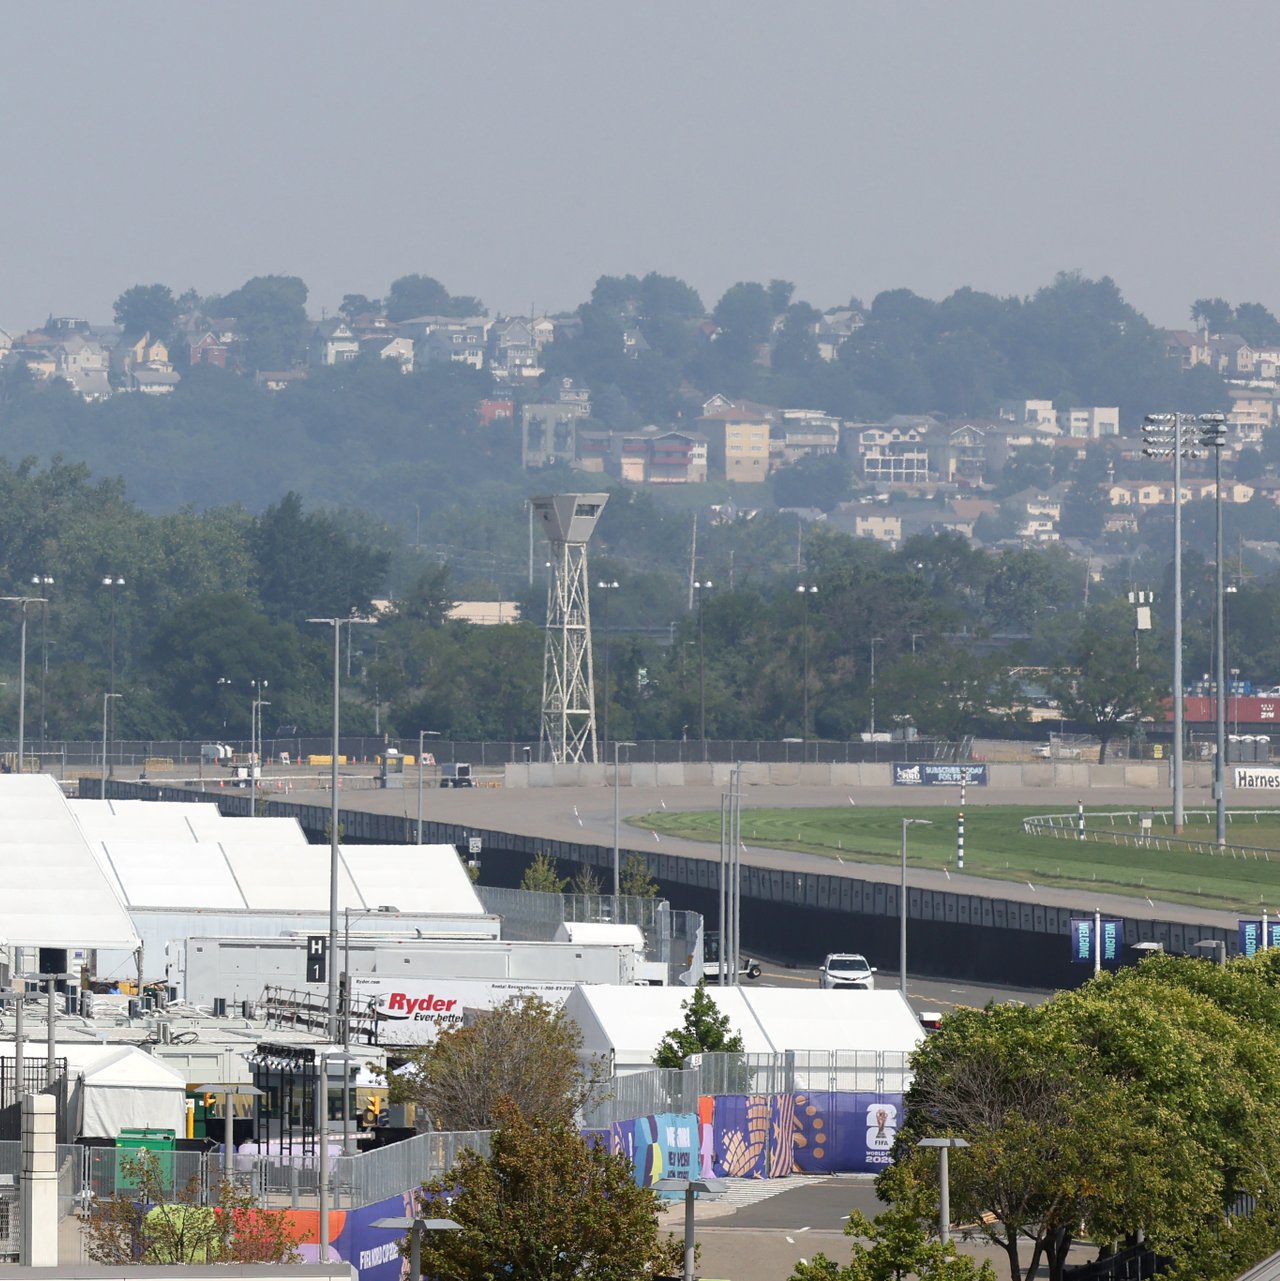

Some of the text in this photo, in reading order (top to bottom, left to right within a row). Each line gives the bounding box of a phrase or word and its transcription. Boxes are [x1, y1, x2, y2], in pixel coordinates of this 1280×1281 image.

[1238, 770, 1280, 787] Harnes
[311, 940, 322, 954] H
[1078, 923, 1089, 959] WELCOME
[1105, 923, 1115, 960] WELCOME
[313, 964, 319, 979] 1
[388, 993, 457, 1014] Ryder
[414, 1012, 435, 1021] Ever
